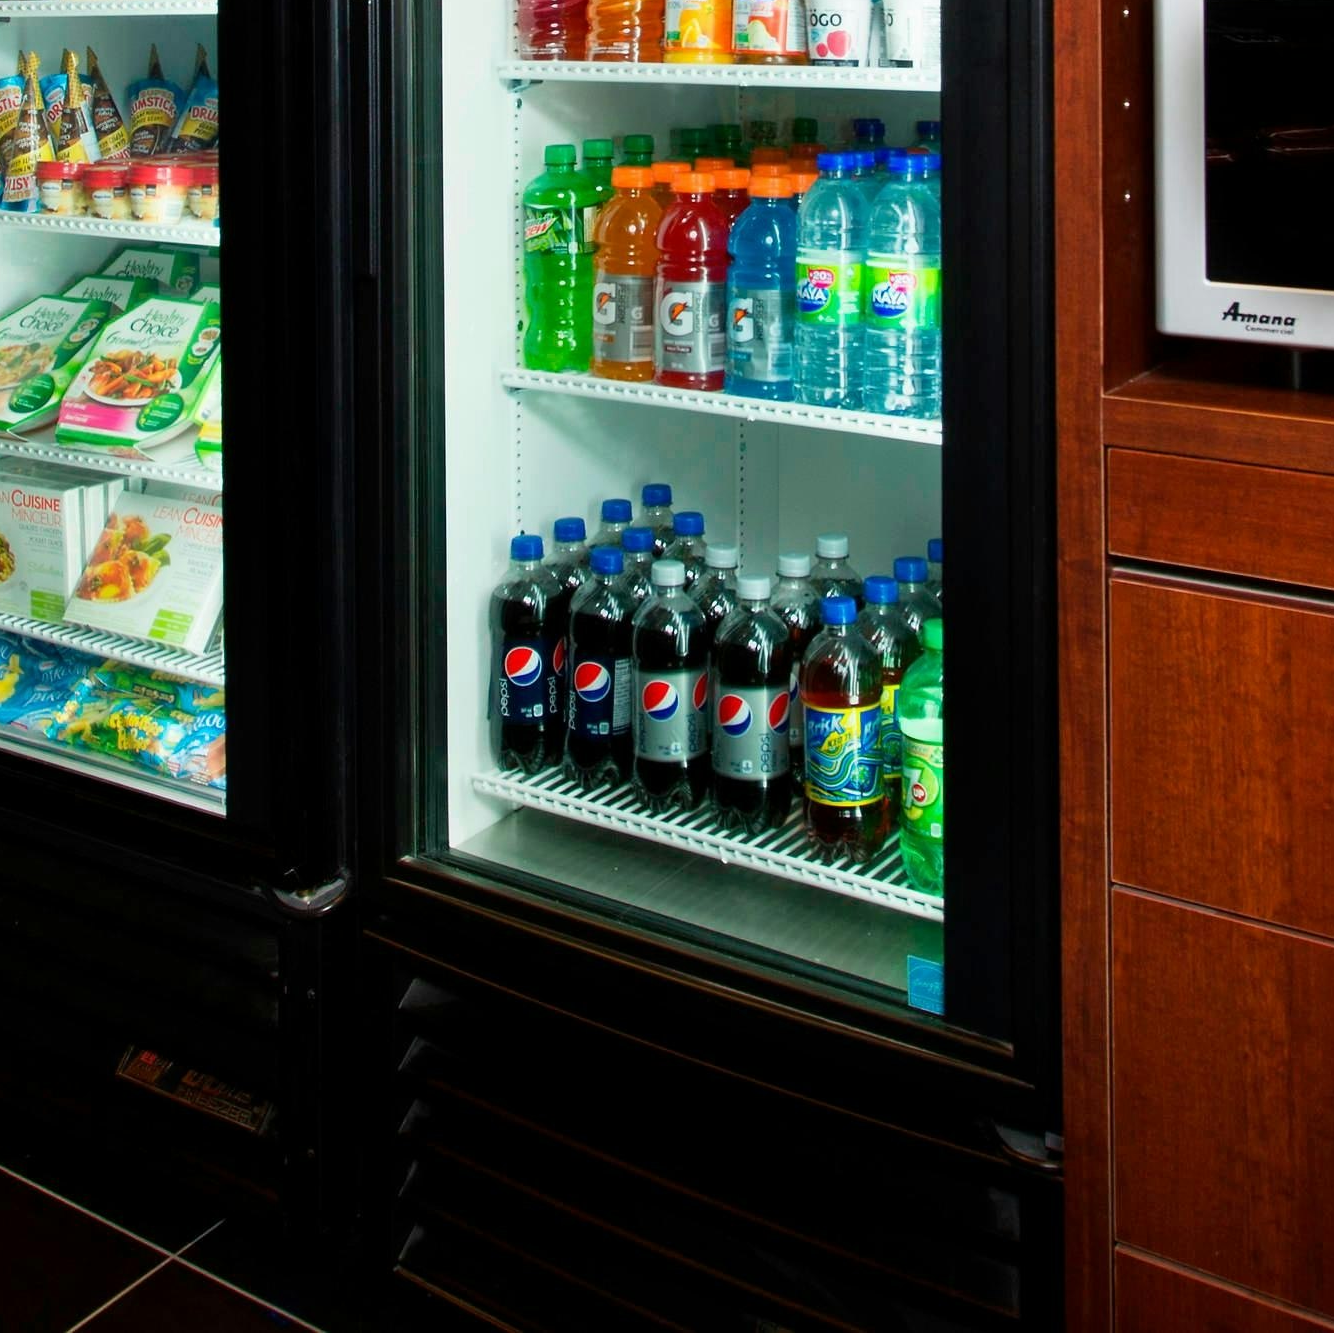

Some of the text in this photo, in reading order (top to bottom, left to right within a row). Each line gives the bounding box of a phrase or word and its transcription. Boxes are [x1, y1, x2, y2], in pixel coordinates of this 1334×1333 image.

[872, 287, 908, 304] NAYA
[19, 315, 65, 331] Choice
[660, 291, 694, 336] G
[1222, 302, 1297, 327] Amana
[130, 317, 179, 338] Choice
[11, 489, 60, 512] CUISINE
[11, 509, 62, 528] MINCEUR
[153, 505, 223, 526] LEAN CUISIN
